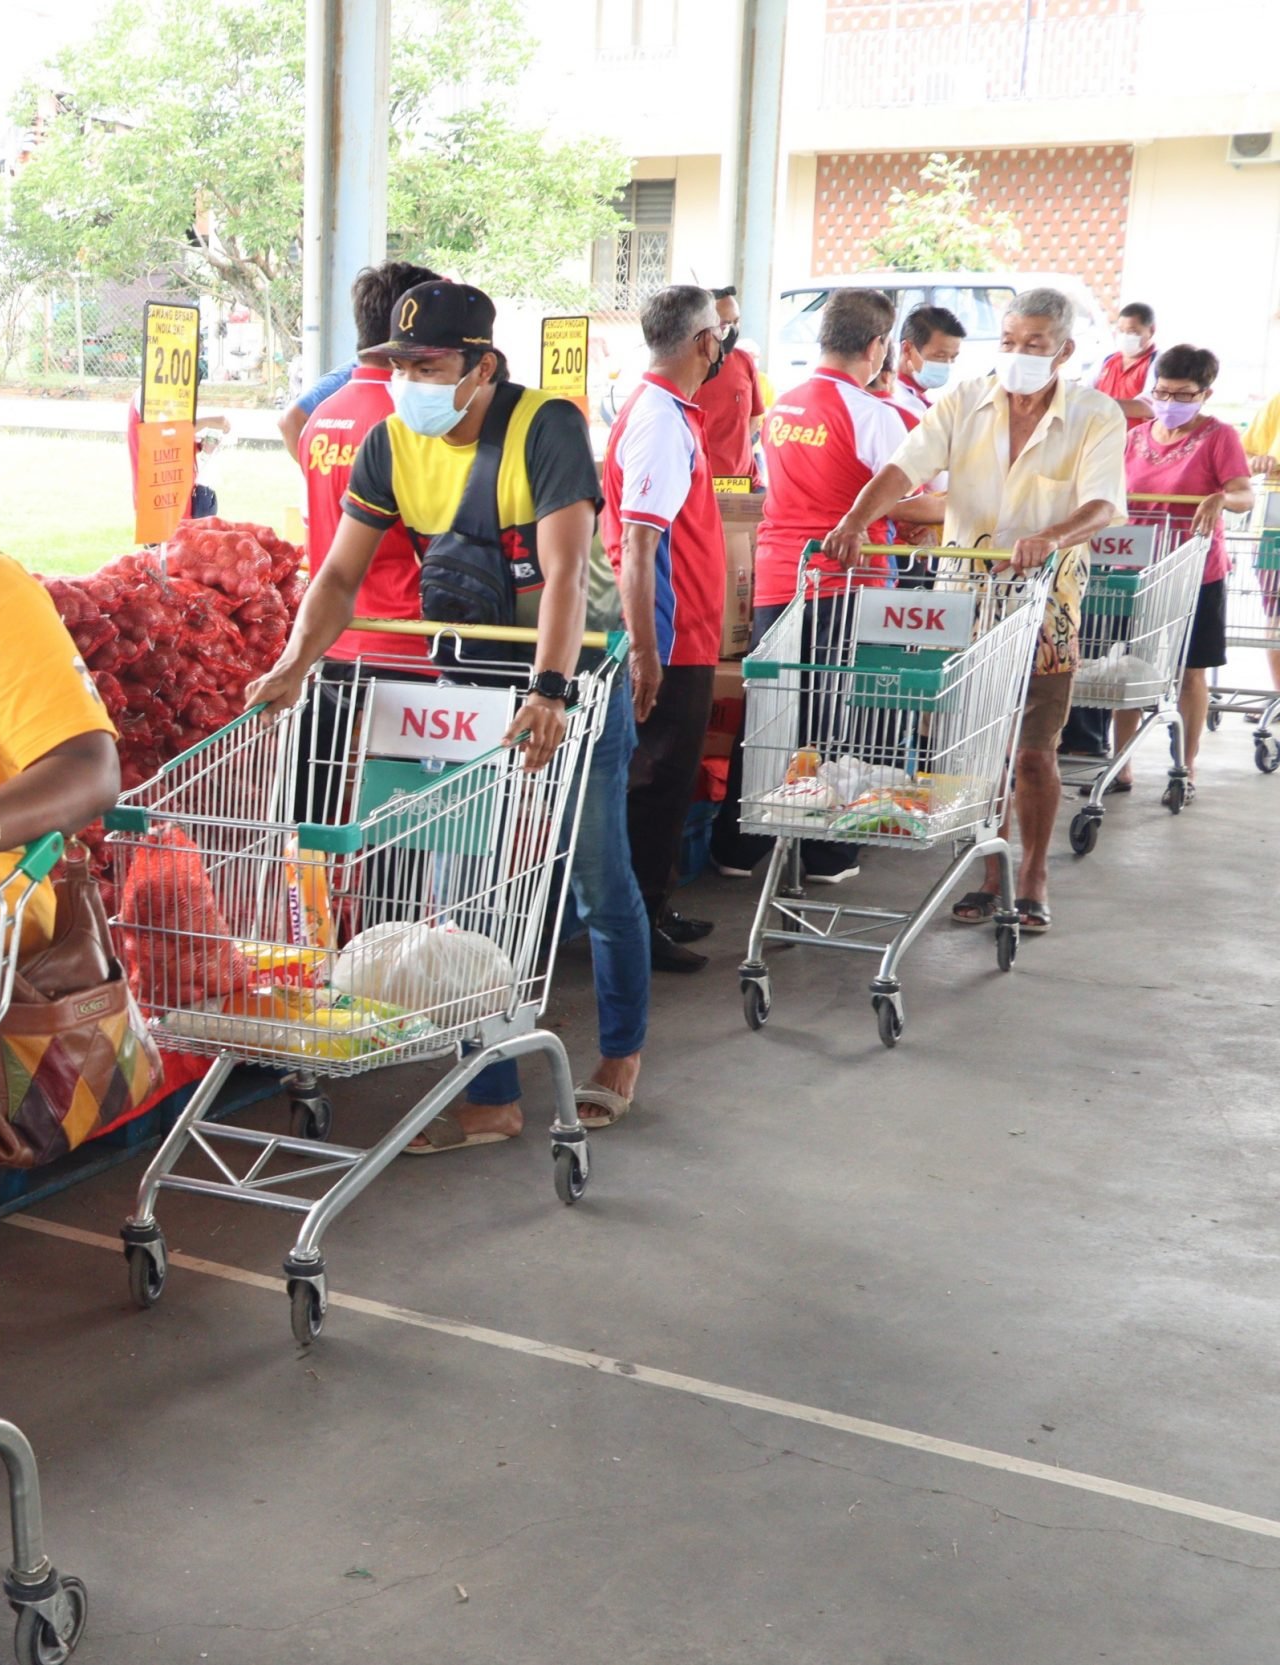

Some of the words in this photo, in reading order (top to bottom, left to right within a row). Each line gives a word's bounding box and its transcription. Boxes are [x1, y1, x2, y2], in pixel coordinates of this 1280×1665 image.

[154, 346, 192, 386] 2.00
[551, 347, 583, 375] 2.00
[767, 415, 828, 448] Rasah
[153, 447, 181, 462] LIMIT
[161, 468, 184, 482] UNIT
[153, 492, 179, 507] ONLY
[1090, 537, 1135, 556] NSK
[883, 606, 947, 631] NSK
[400, 707, 480, 742] NSK
